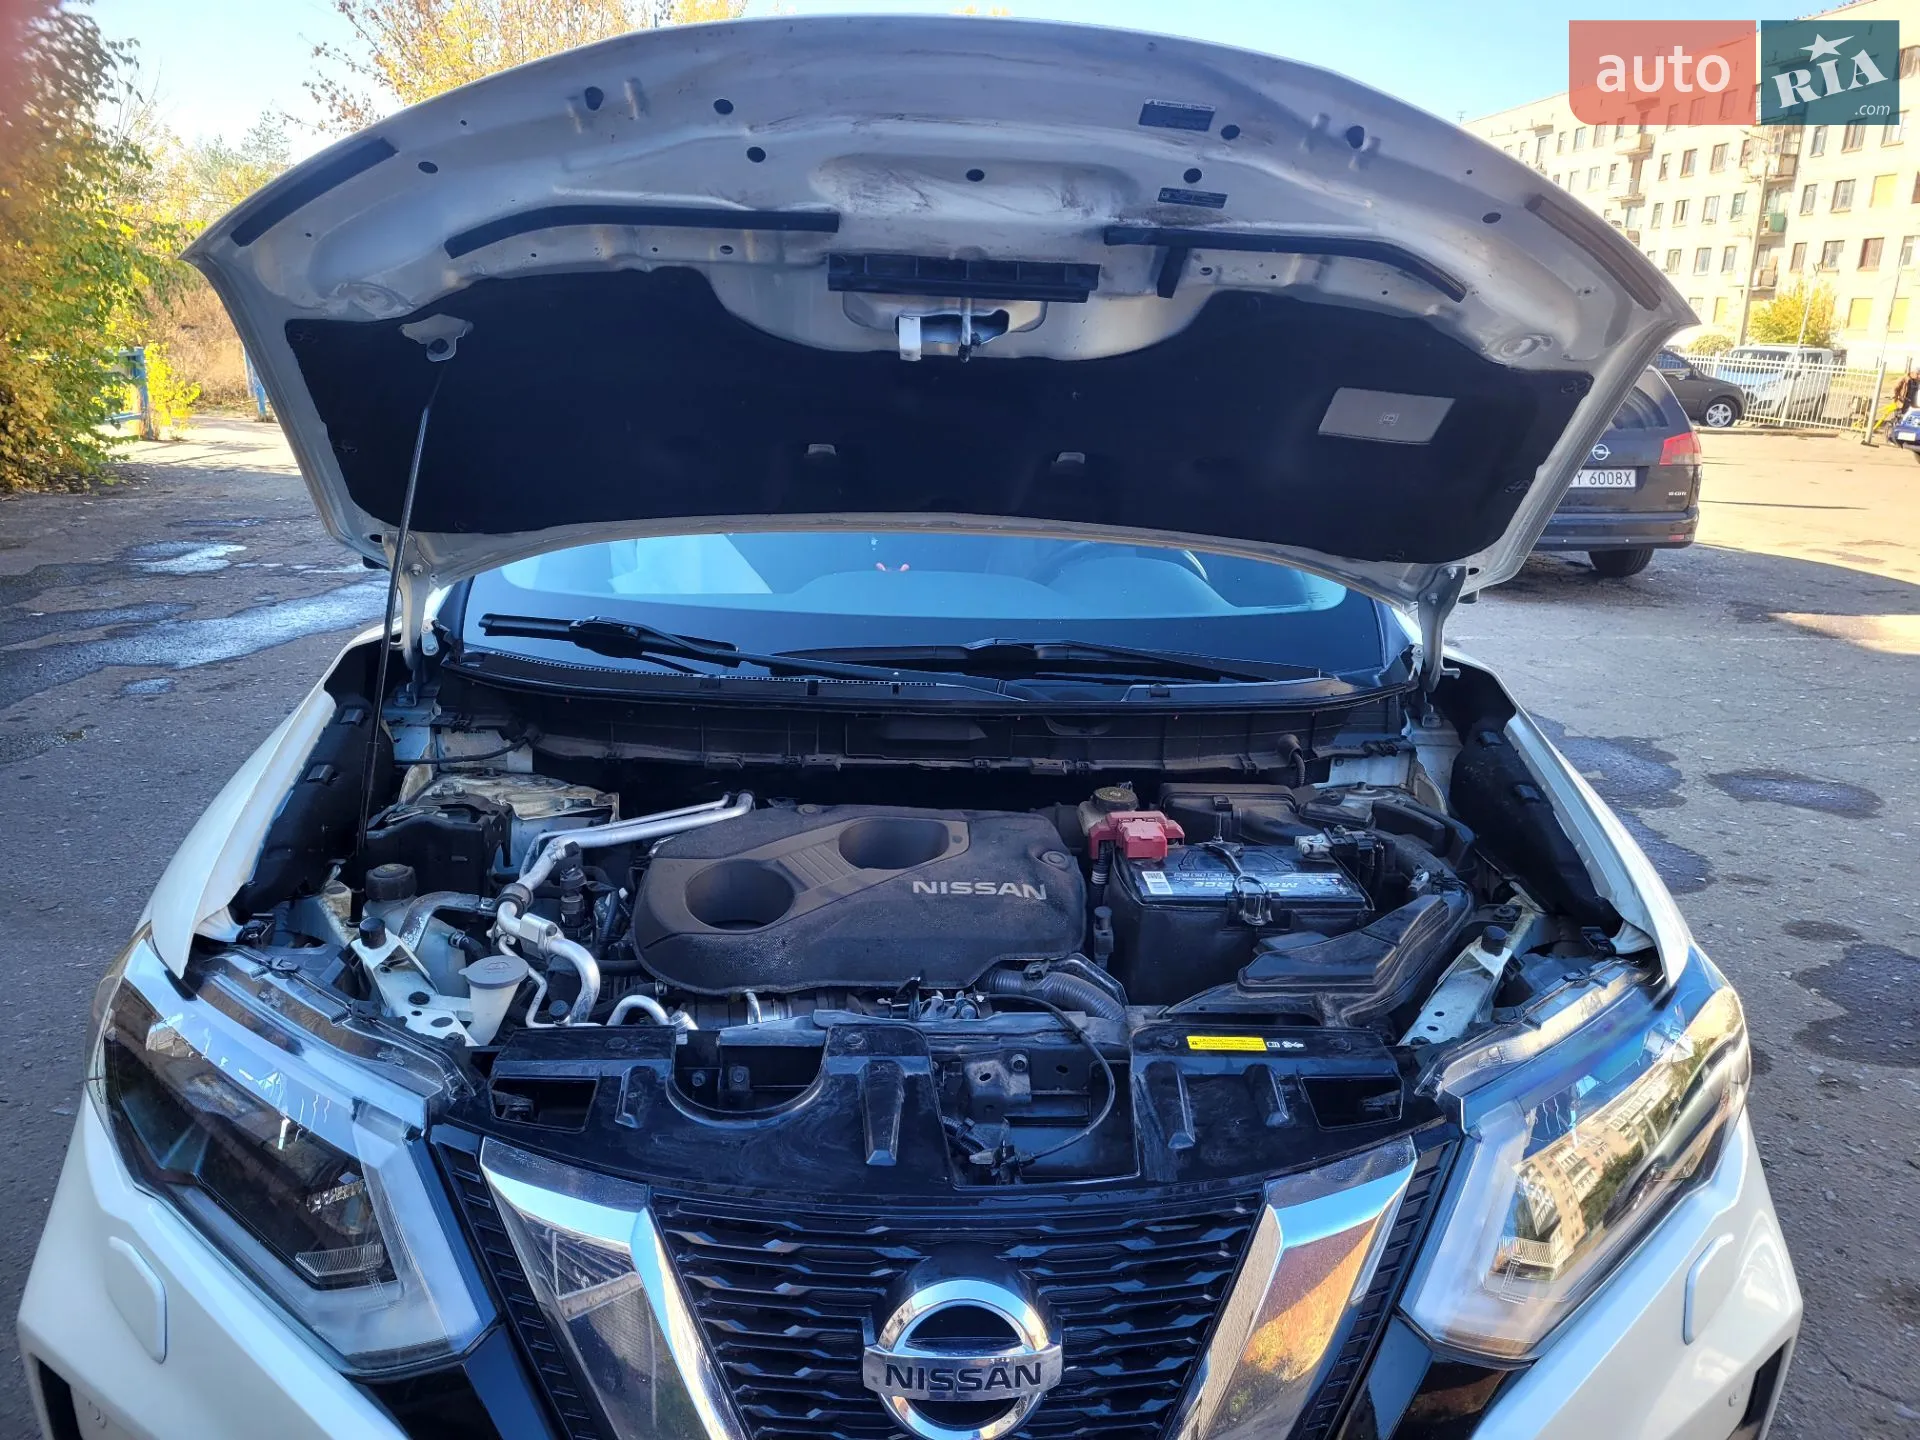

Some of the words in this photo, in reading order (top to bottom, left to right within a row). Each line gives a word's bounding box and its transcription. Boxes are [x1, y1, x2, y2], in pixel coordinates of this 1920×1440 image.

[1590, 471, 1632, 485] 6008X
[912, 880, 1047, 900] NISSAN
[885, 1362, 1042, 1393] NISSAN
